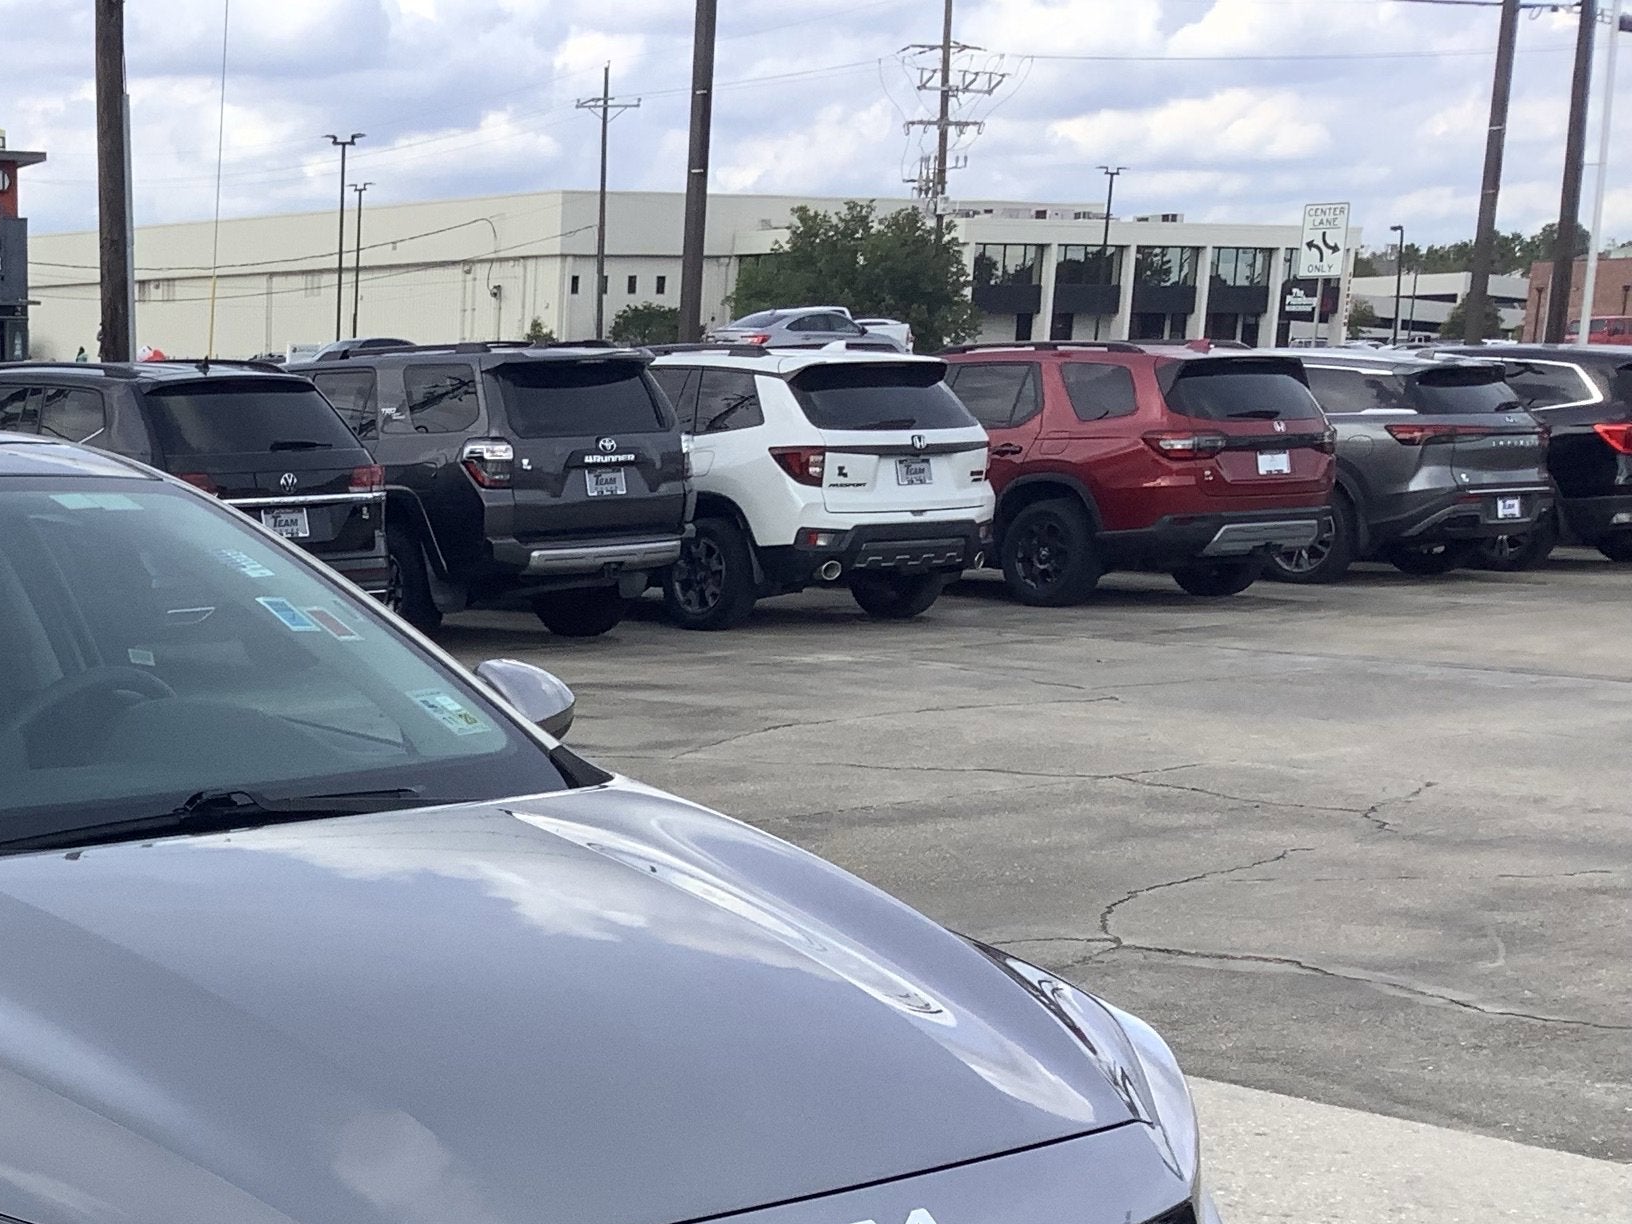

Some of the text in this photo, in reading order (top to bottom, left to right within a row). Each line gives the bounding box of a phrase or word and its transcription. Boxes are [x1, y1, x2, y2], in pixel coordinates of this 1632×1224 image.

[1308, 207, 1345, 217] CENTER
[1312, 219, 1338, 227] LANE
[1308, 264, 1333, 273] ONLY
[584, 453, 635, 463] 4RUNNER
[272, 515, 298, 527] TEAM
